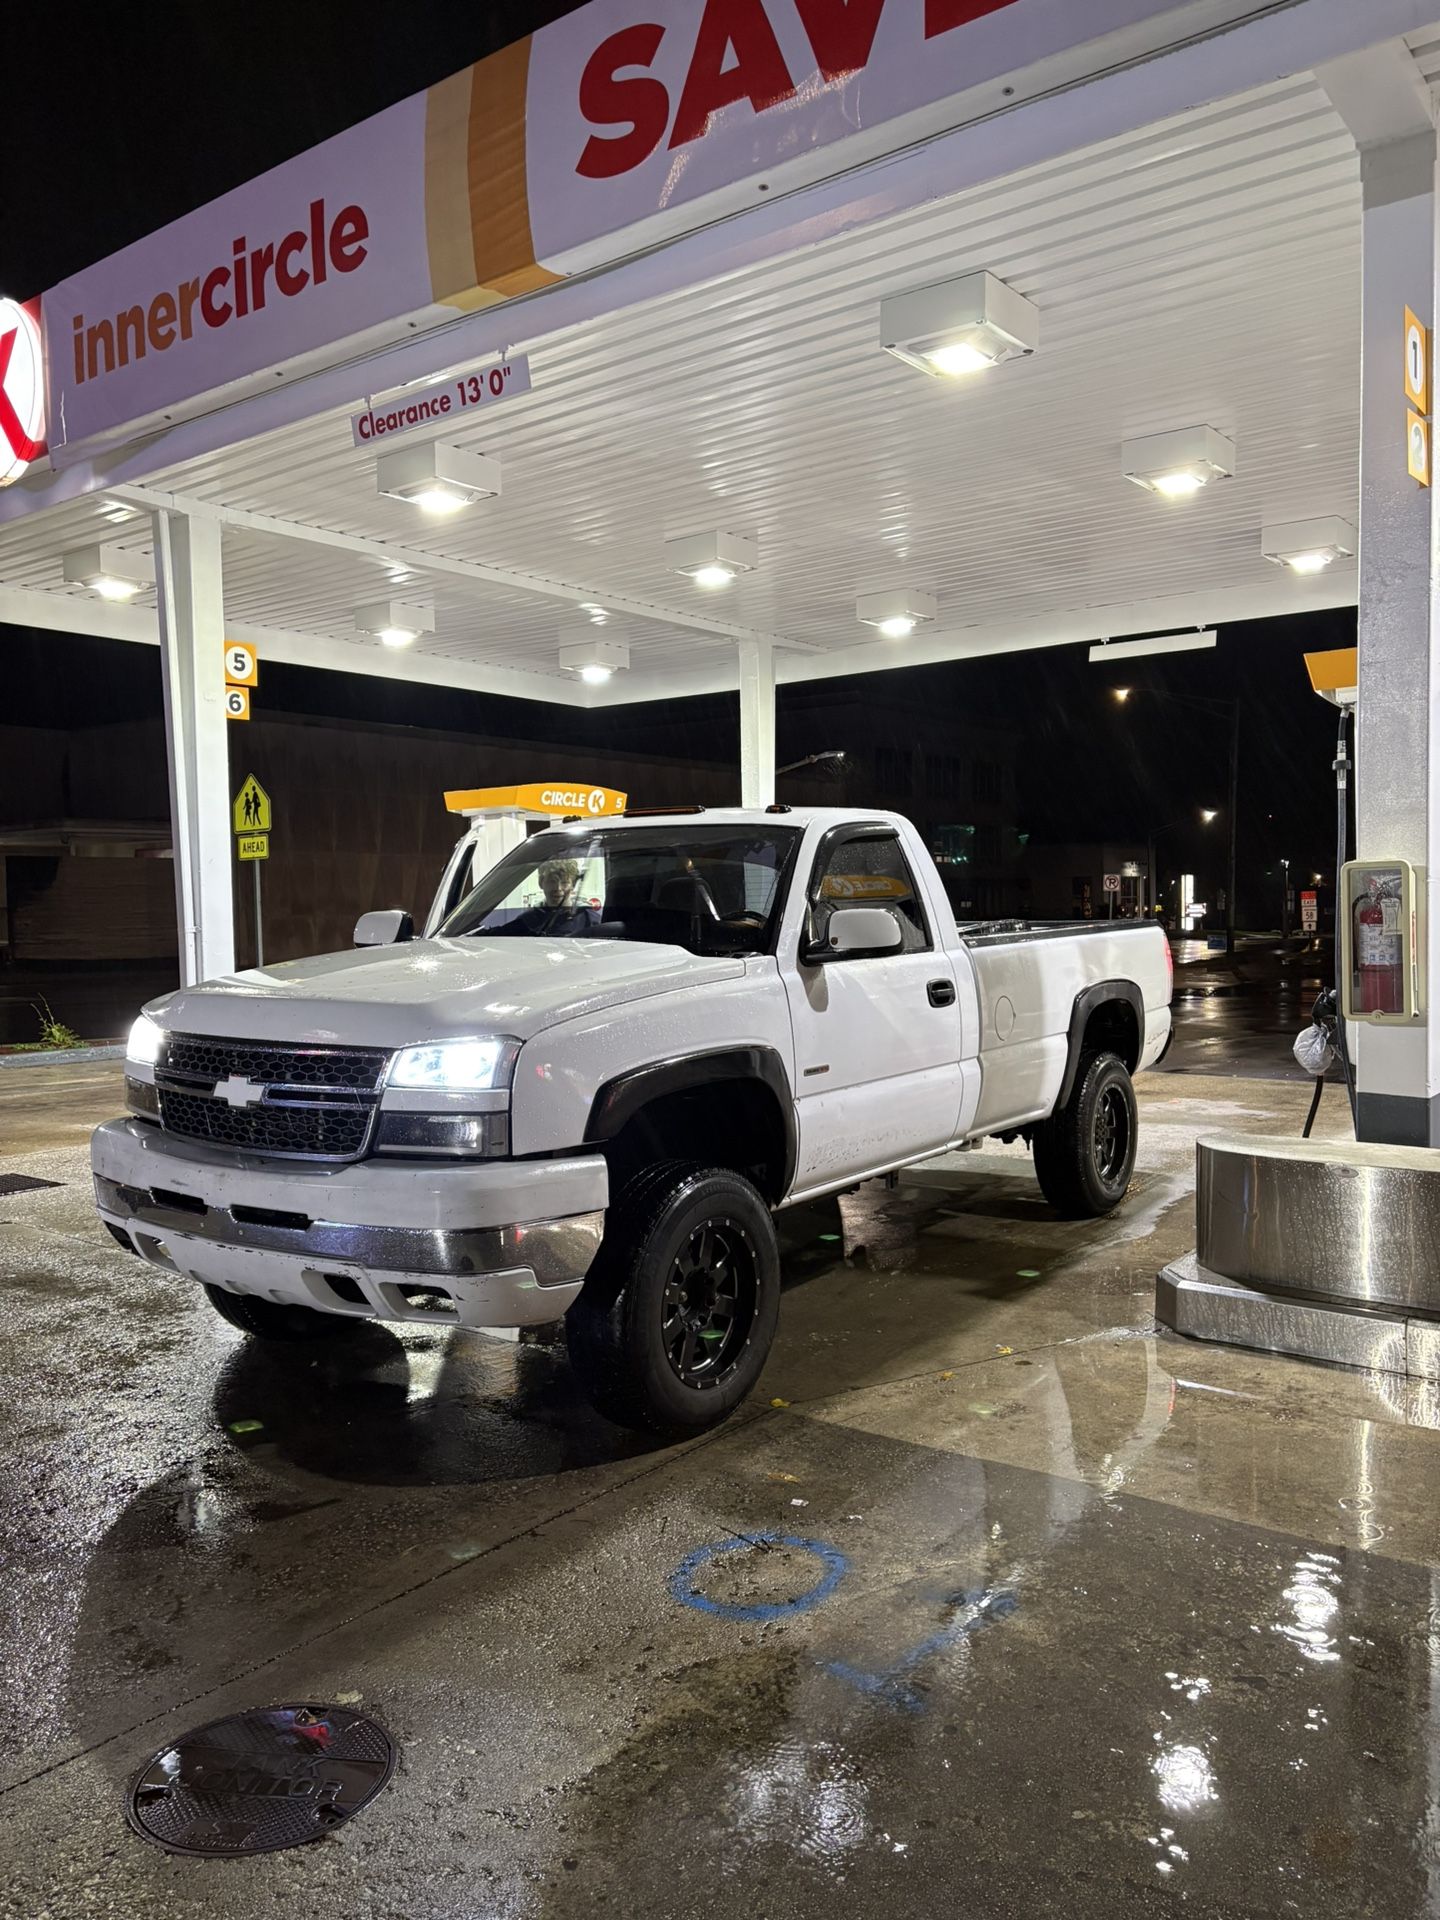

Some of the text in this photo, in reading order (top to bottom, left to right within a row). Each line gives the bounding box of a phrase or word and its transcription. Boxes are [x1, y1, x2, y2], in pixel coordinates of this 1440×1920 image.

[576, 0, 1020, 178] SAV
[73, 198, 369, 385] innercircle
[358, 366, 512, 440] Clearance 13' 0"
[233, 652, 246, 672] 5
[229, 693, 242, 712] 6
[541, 791, 586, 808] CIRCLE
[616, 797, 623, 809] 5
[242, 841, 264, 854] AHEAD
